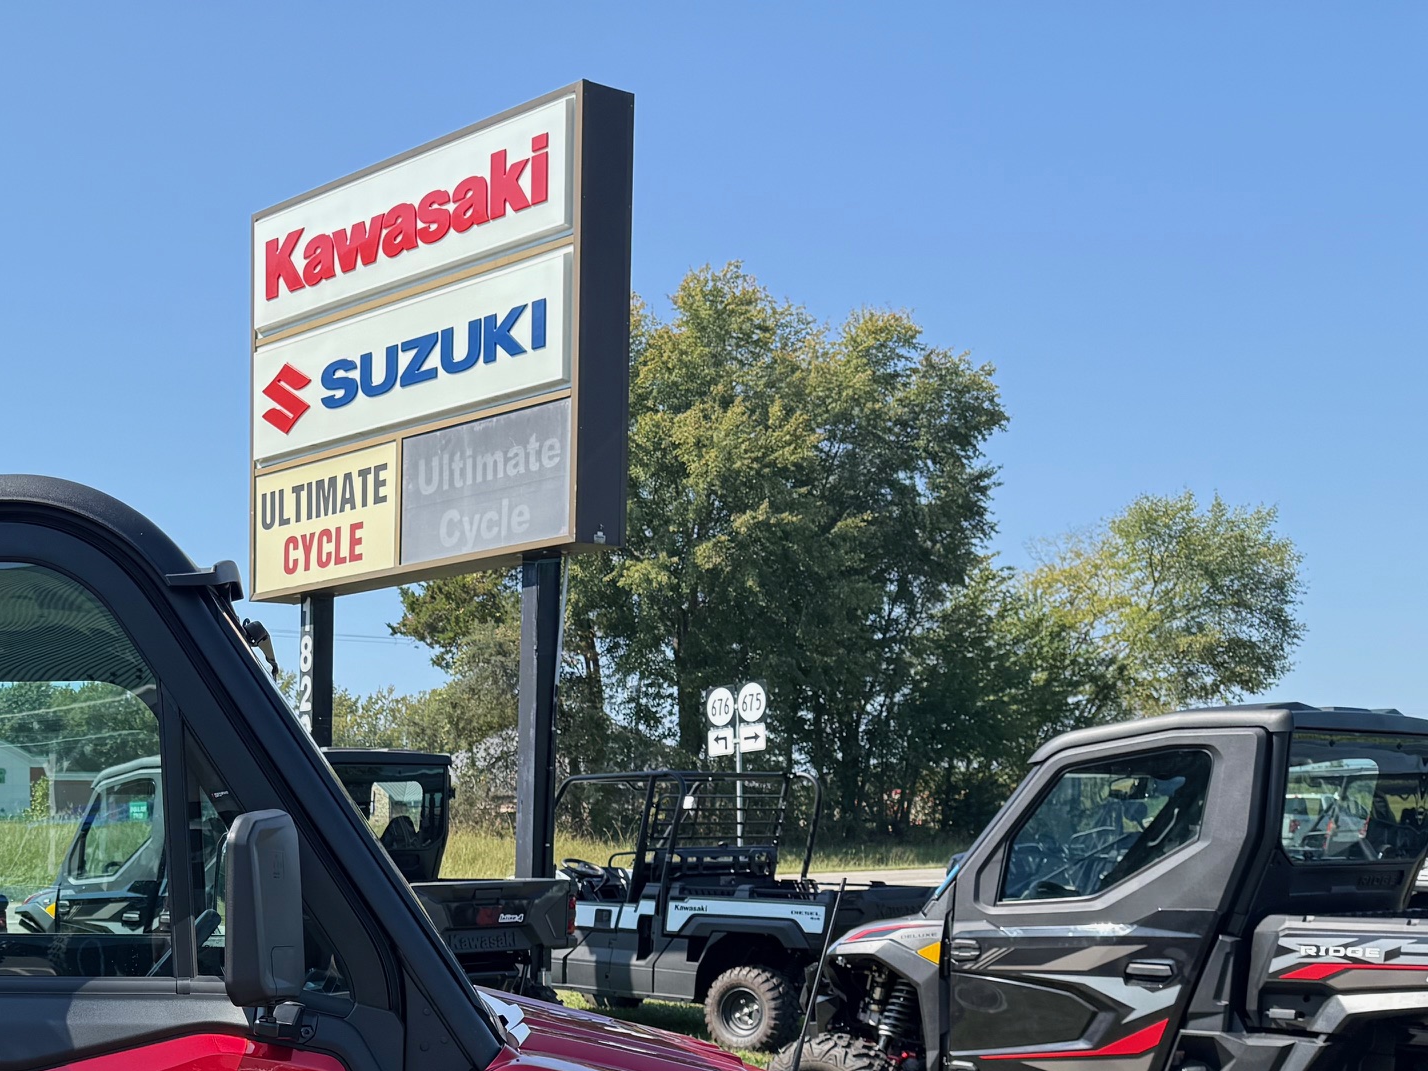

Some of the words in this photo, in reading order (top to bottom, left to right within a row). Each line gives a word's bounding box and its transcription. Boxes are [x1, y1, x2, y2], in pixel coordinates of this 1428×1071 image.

[265, 132, 549, 301] Kawasaki
[320, 297, 547, 410] SUZUKI
[417, 435, 562, 496] Ultimate
[261, 462, 388, 532] ULTIMATE
[283, 521, 364, 576] CYCLE
[439, 499, 531, 554] Cycle
[711, 697, 729, 717] 676
[741, 692, 762, 712] 675
[674, 904, 708, 912] Kawasaki
[448, 931, 517, 950] Kawasaki
[1300, 945, 1381, 958] RIDGE
